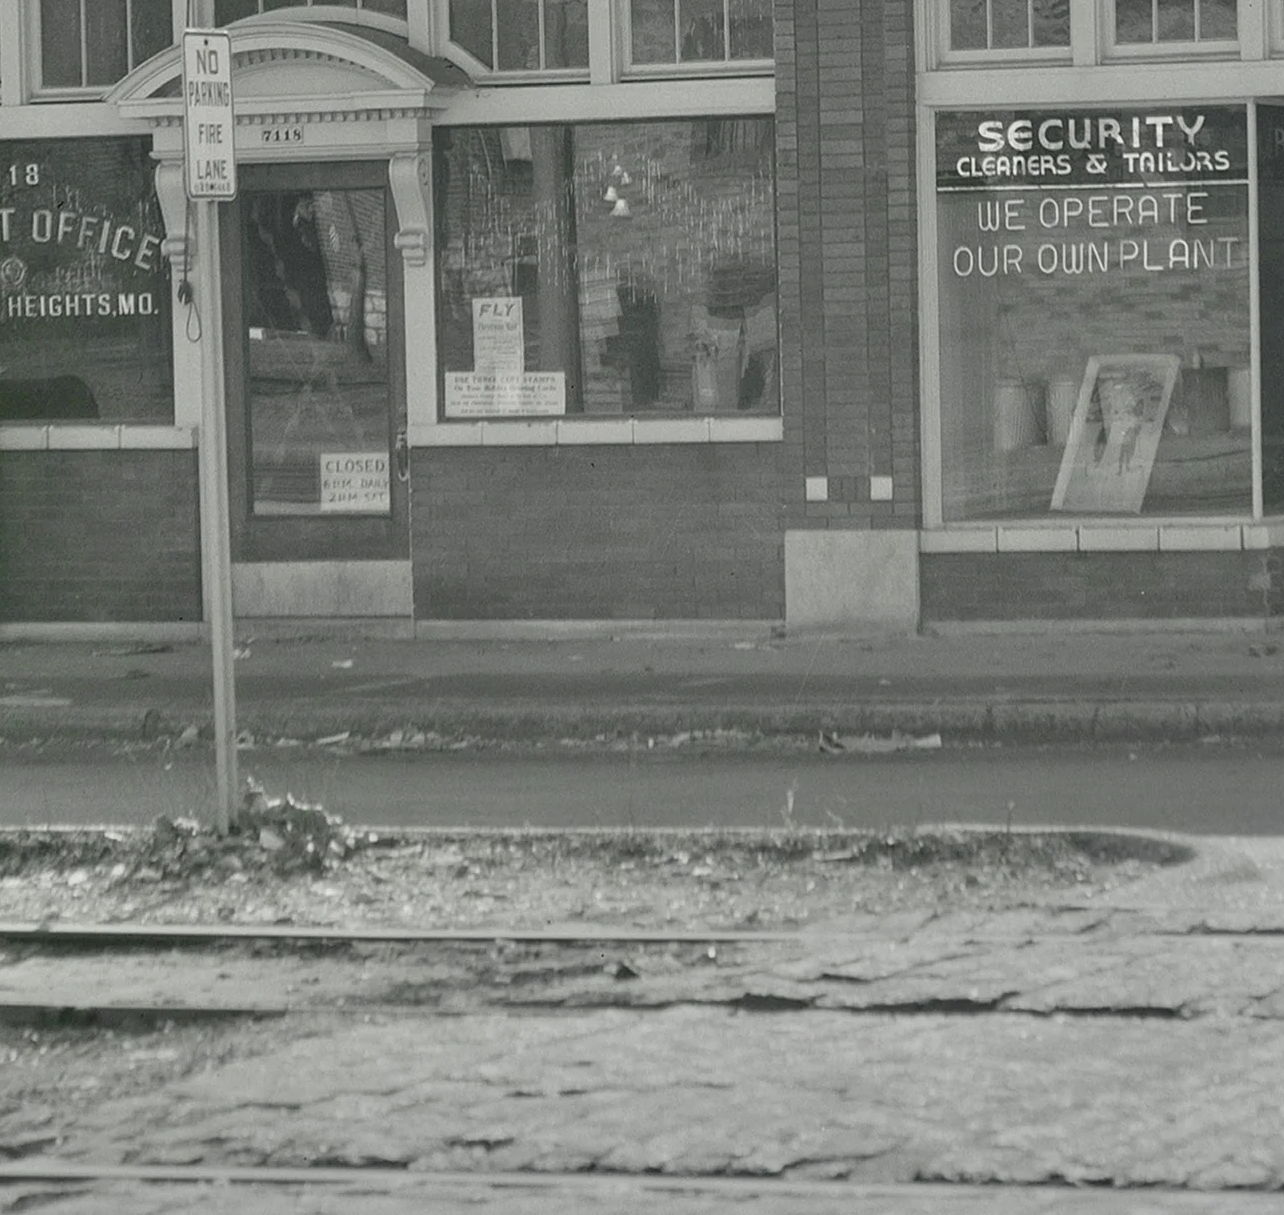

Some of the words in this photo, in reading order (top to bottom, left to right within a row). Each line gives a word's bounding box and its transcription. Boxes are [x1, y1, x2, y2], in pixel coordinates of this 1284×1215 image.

[196, 49, 219, 75] NO
[188, 81, 230, 108] PARKING
[198, 123, 223, 145] FIRE
[262, 129, 302, 142] 7118
[977, 115, 1205, 152] SECURITY
[196, 159, 228, 181] LANE
[955, 154, 1073, 178] CLEANERS
[1085, 154, 1108, 175] &
[1122, 150, 1231, 174] TAILORS
[977, 199, 1026, 232] WE
[1038, 192, 1209, 229] OPERATE
[31, 209, 161, 272] OFFICE
[953, 243, 1024, 277] OUR
[1037, 240, 1109, 275] OWN
[1119, 237, 1240, 272] PLANT
[118, 292, 160, 316] MO.
[479, 303, 515, 318] FLY
[325, 458, 385, 474] CLOSED
